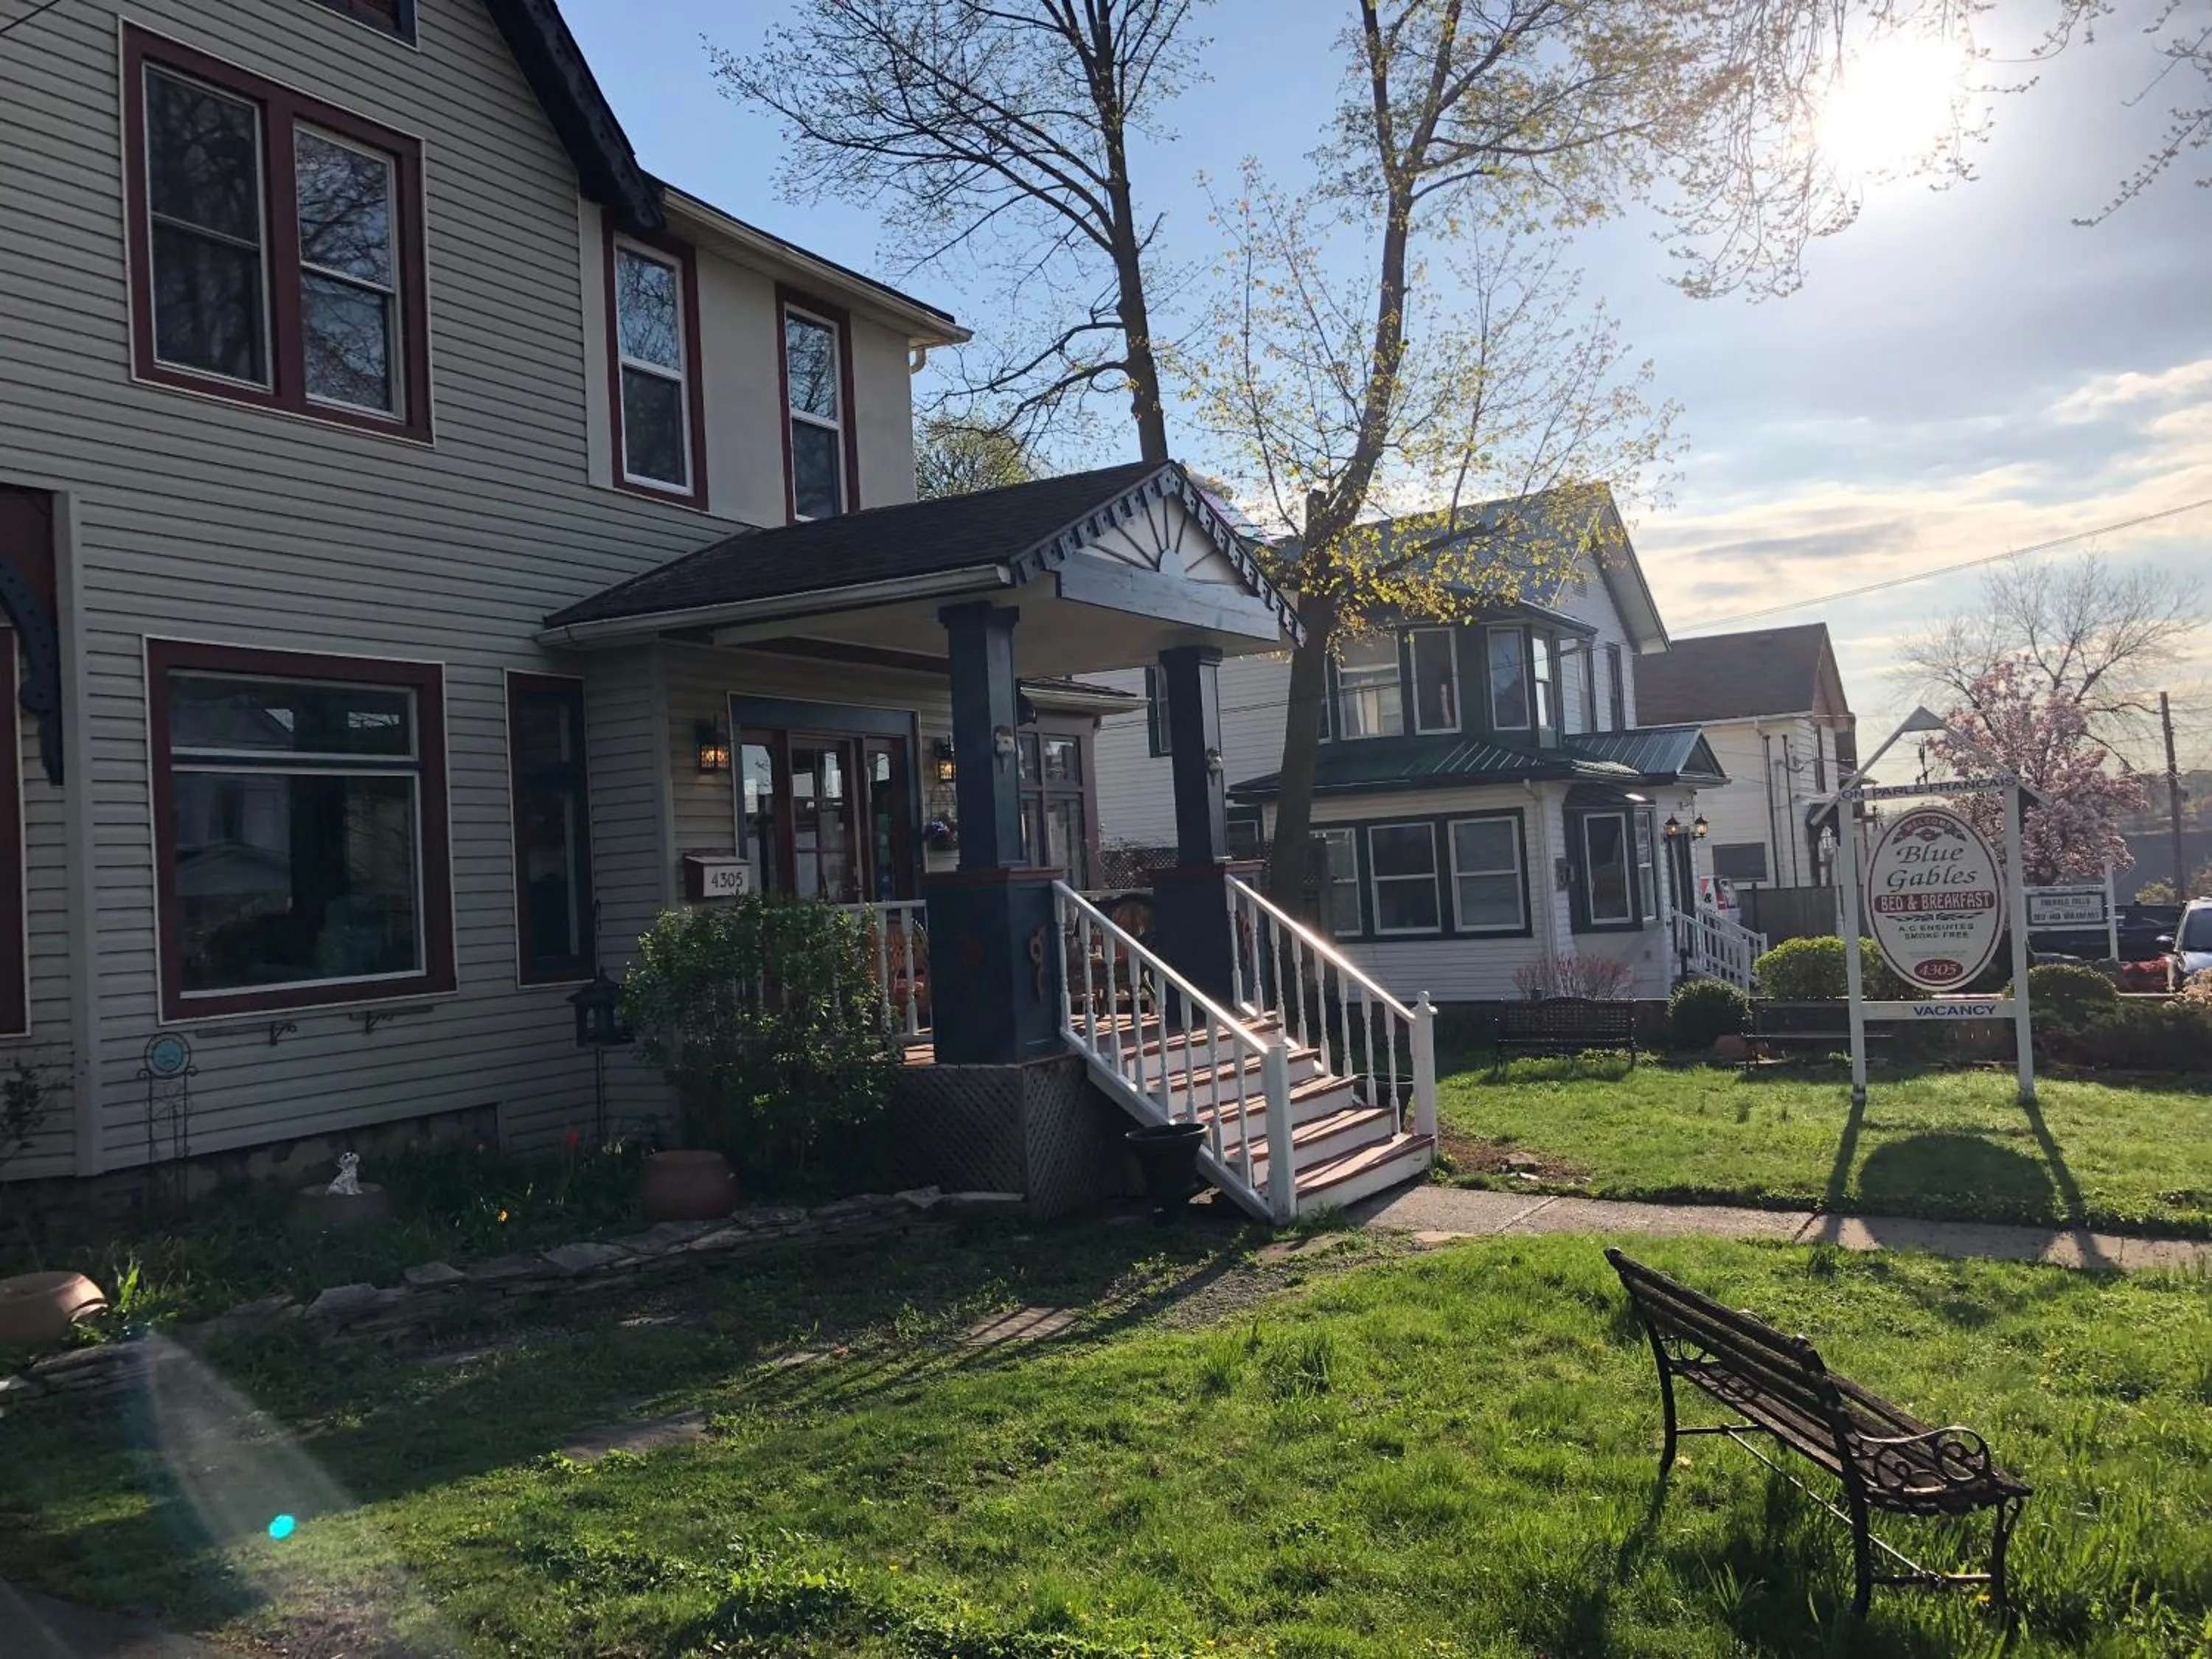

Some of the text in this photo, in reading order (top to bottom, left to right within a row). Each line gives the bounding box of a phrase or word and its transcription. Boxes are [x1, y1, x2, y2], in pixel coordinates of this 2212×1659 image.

[1842, 790, 1865, 799] ON
[1873, 785, 1924, 797] PARLE
[1896, 843, 1964, 863] Blue
[712, 872, 743, 888] 4305
[1888, 864, 1978, 892] Gables
[1881, 891, 1990, 911] BED & BREAKFAST
[1919, 964, 1958, 975] 4305
[1913, 1005, 1996, 1015] VACANCY
